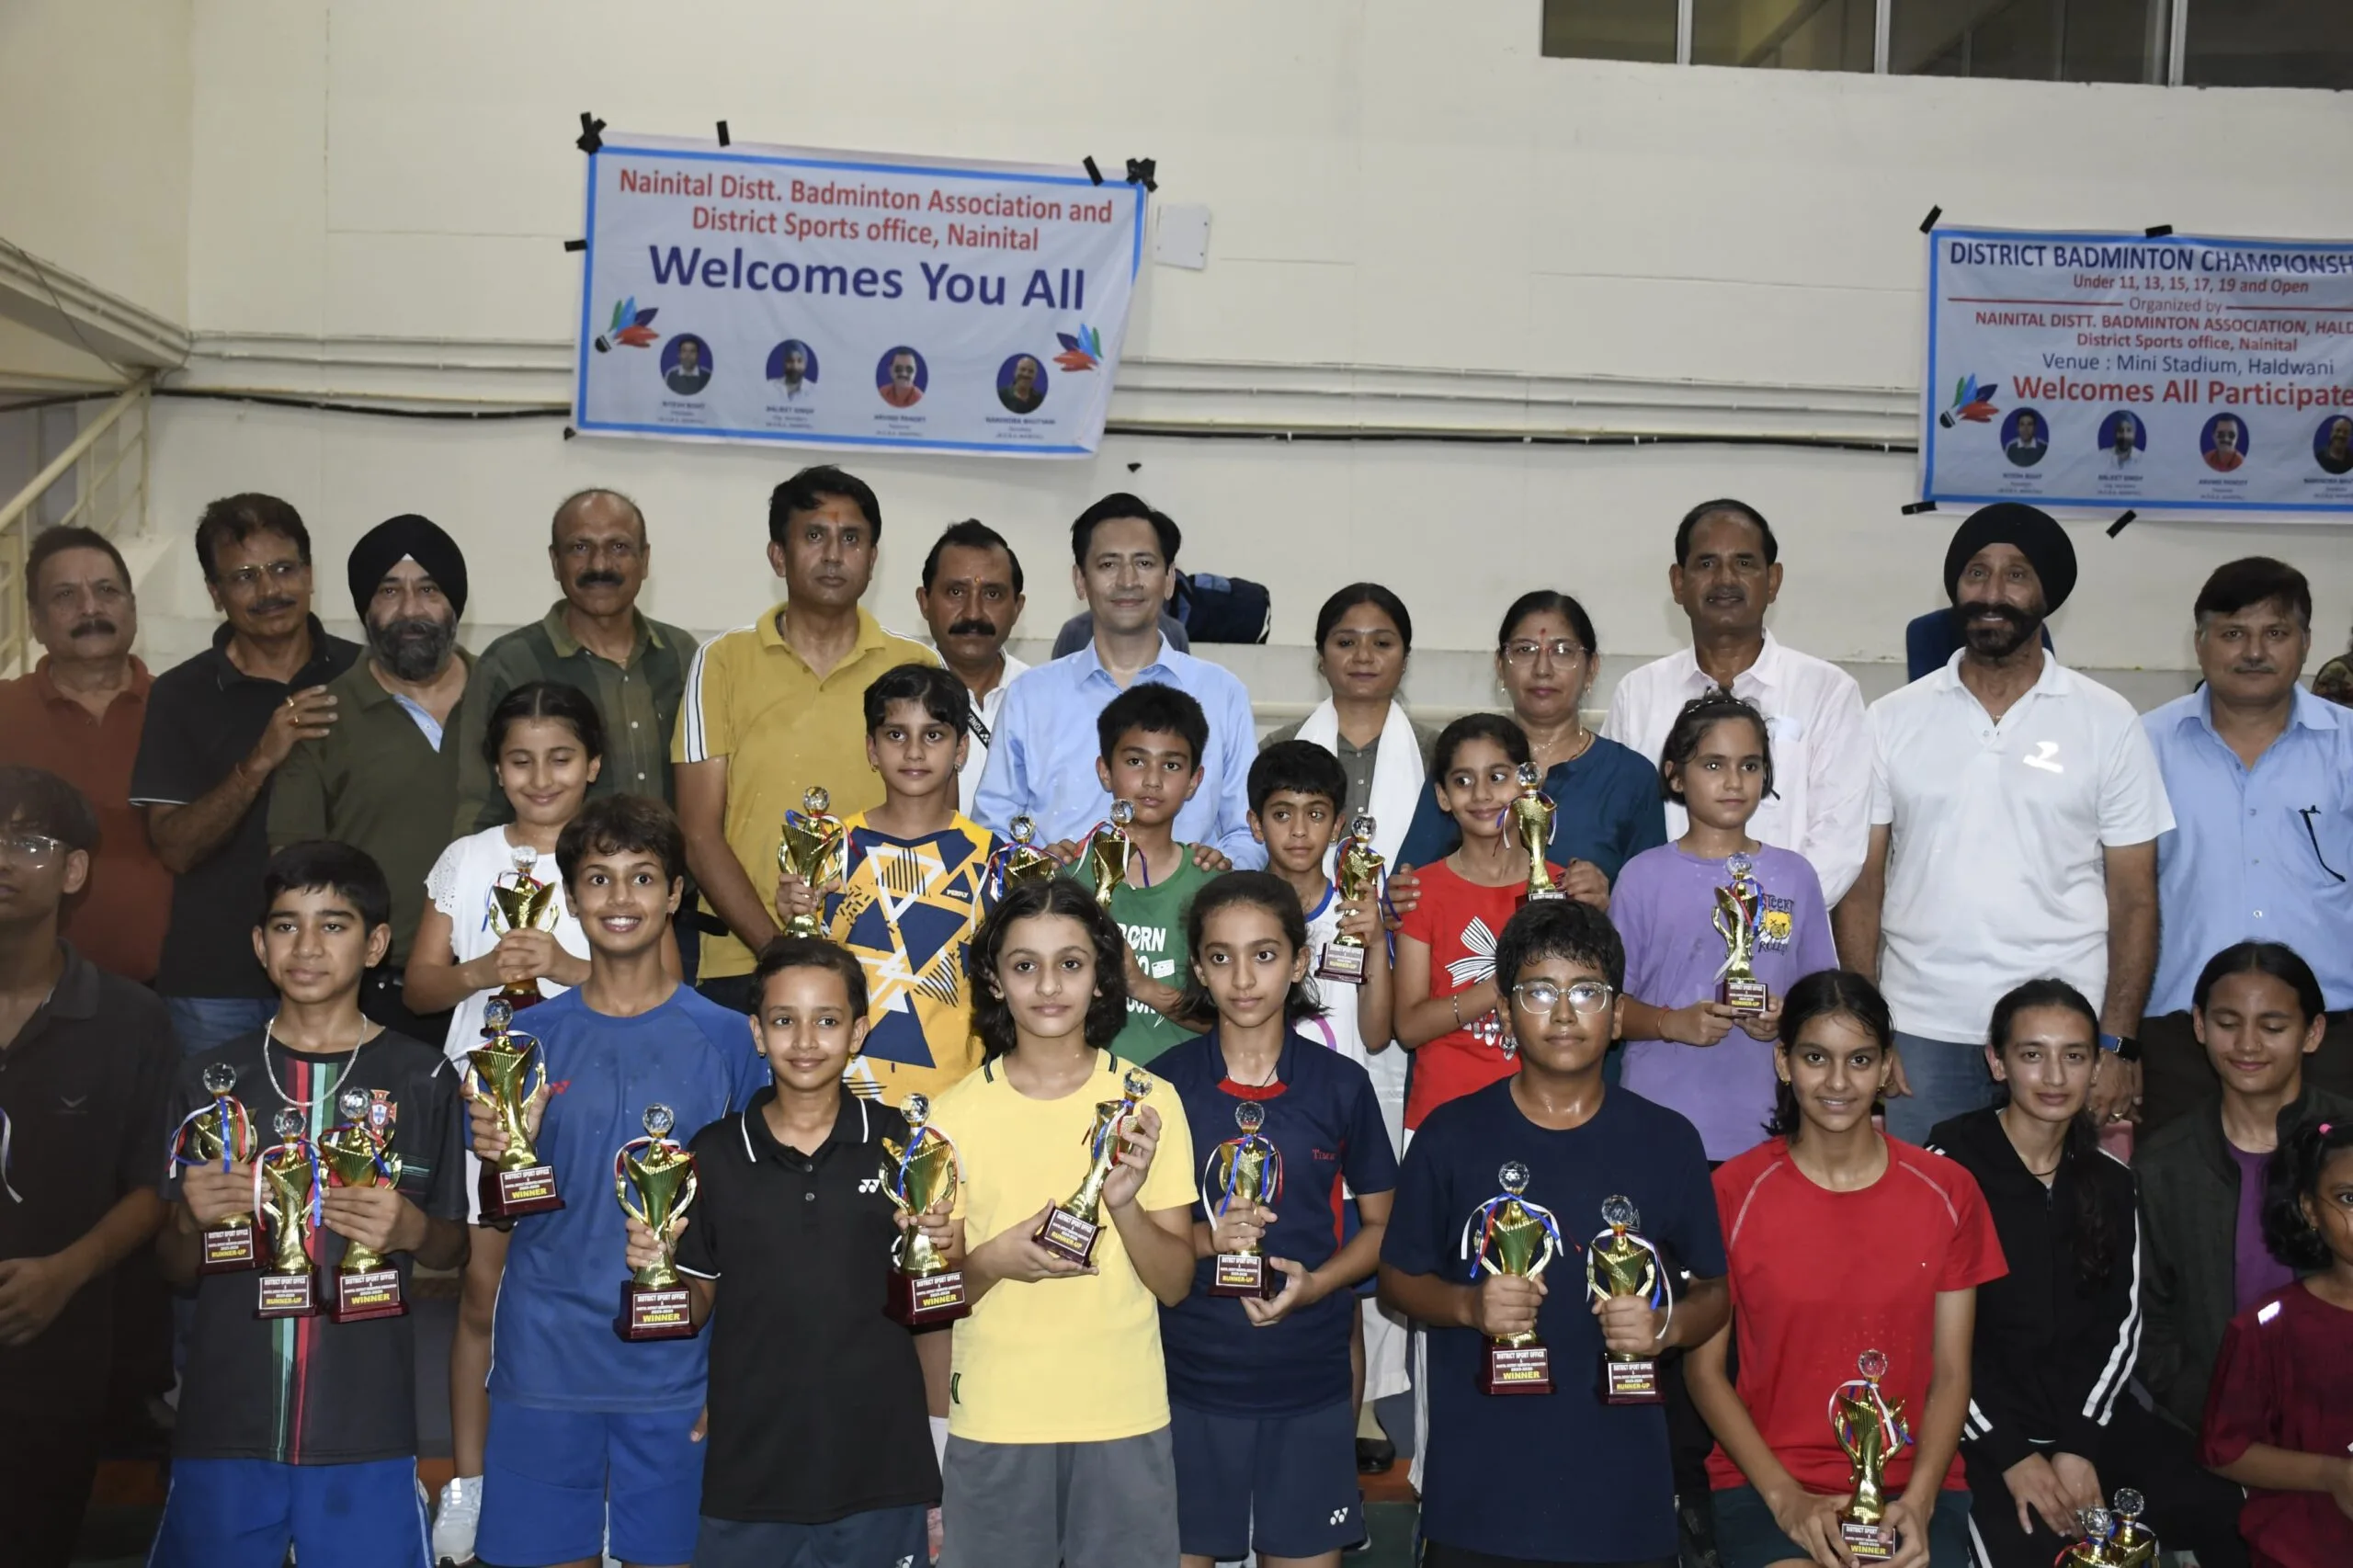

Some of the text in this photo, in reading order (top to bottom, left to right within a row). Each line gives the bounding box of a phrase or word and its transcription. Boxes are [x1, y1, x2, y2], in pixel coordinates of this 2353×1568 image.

[620, 168, 1113, 223] Nainital Distt. Badminton Association and
[692, 206, 1039, 251] District Sports office, Nainital
[1949, 242, 2353, 274] DISTRICT BADMINTON CHAMPIONSH
[649, 244, 1085, 310] Welcomes You All
[2074, 274, 2309, 296] Under 11, 13, 15, 17, 19 and Open
[2129, 297, 2222, 314] Organized by
[1975, 312, 2046, 327] NAINITAL
[2051, 314, 2097, 328] DISTT.
[2102, 315, 2200, 330] BADMINTON
[2203, 318, 2311, 335] ASSOCIATION,
[2077, 333, 2298, 352] District Sports office, Nainital
[2042, 353, 2099, 370] Venue
[2117, 355, 2157, 371] Mini
[2163, 355, 2243, 375] Stadium,
[2249, 358, 2334, 375] Haldwani
[2013, 375, 2353, 412] Welcomes All Participate
[512, 1187, 547, 1199] WINNER
[351, 1293, 390, 1304] WINNER
[923, 1294, 957, 1306] WINNER
[643, 1313, 680, 1323] WINNER
[1504, 1371, 1540, 1380] WINNER
[1851, 1545, 1885, 1554] WINNER
